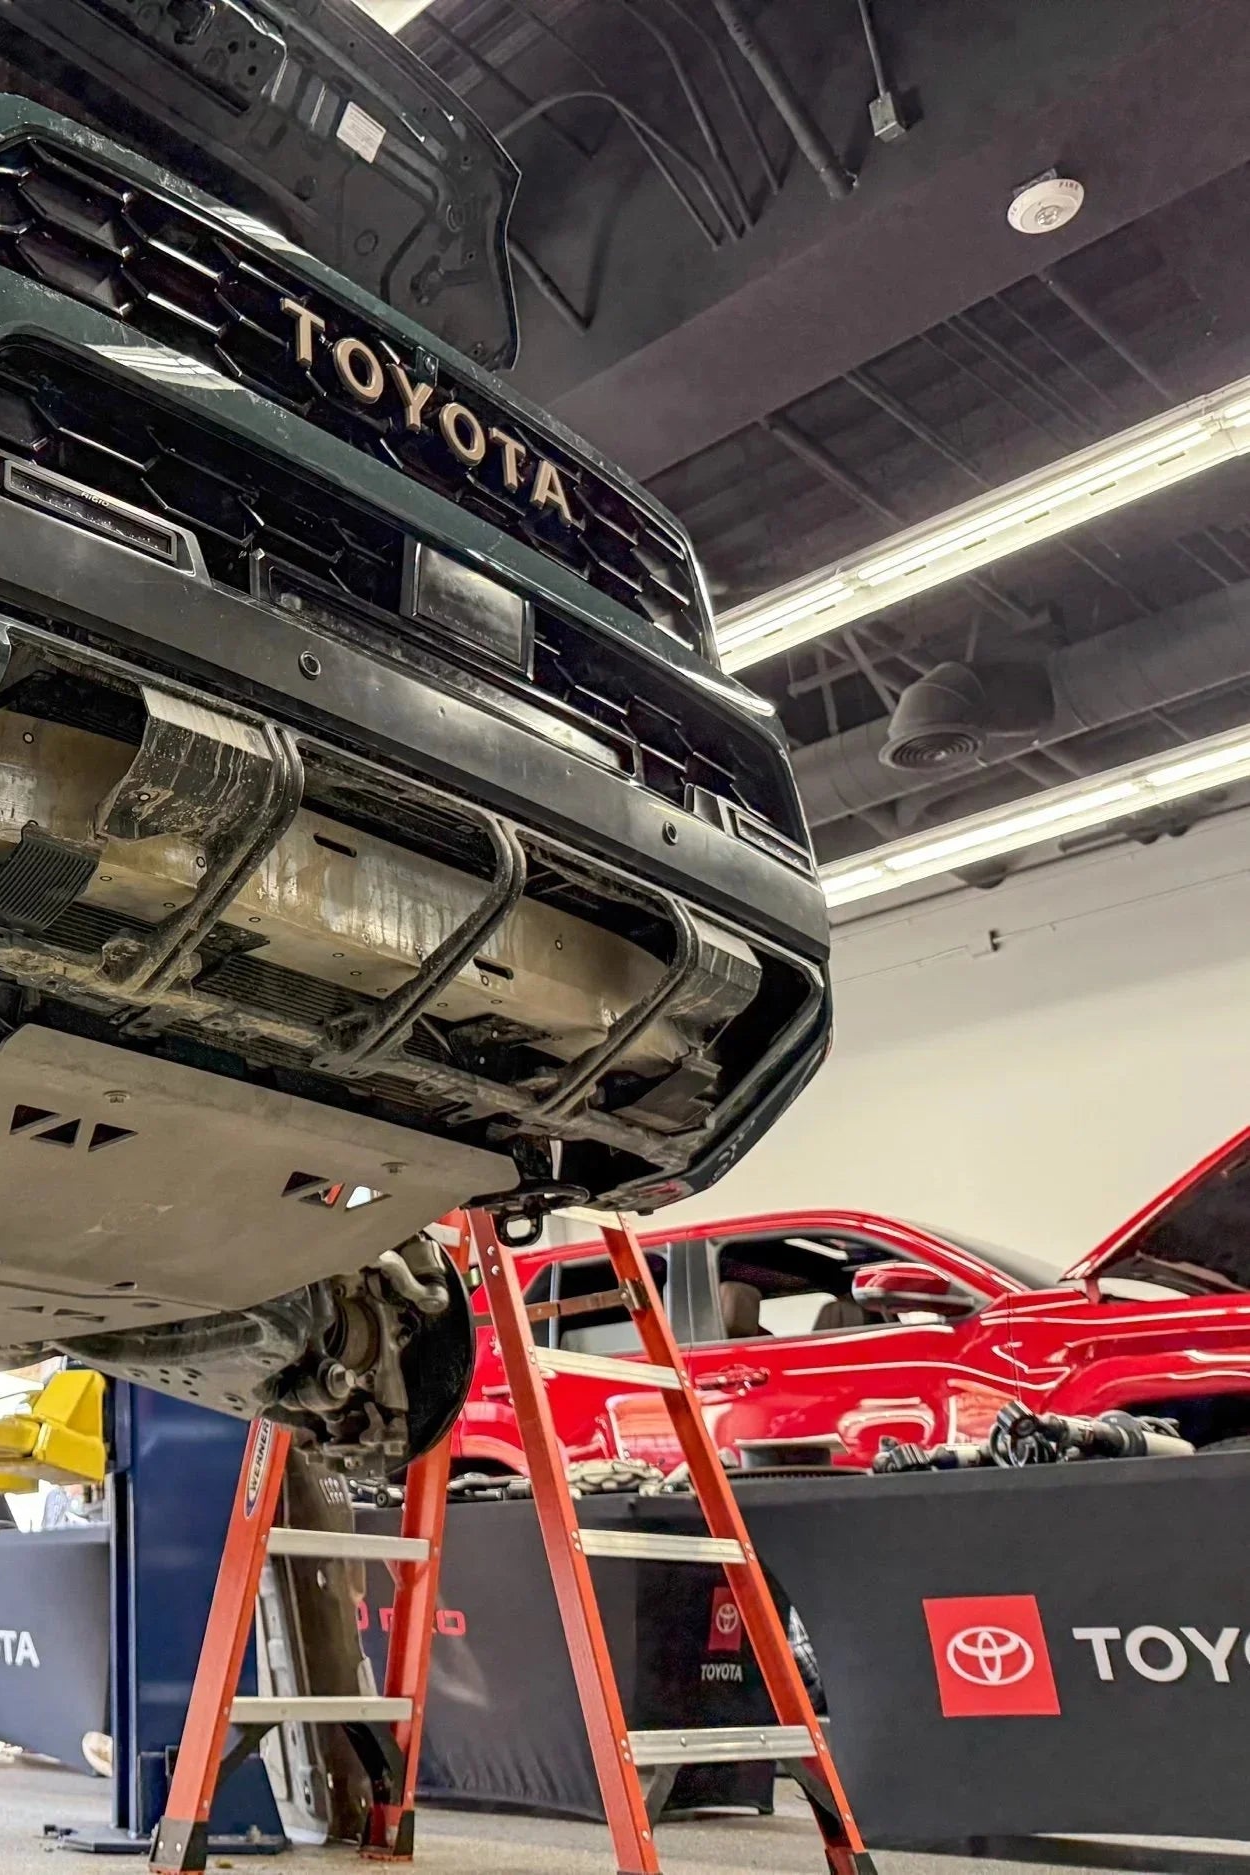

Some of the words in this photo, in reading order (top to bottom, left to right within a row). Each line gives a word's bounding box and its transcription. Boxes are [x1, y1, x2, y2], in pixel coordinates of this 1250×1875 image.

[279, 297, 574, 528] TOYOTA
[250, 1421, 269, 1491] WERNER
[701, 1663, 743, 1682] TOYOTA
[1071, 1625, 1250, 1683] TOY
